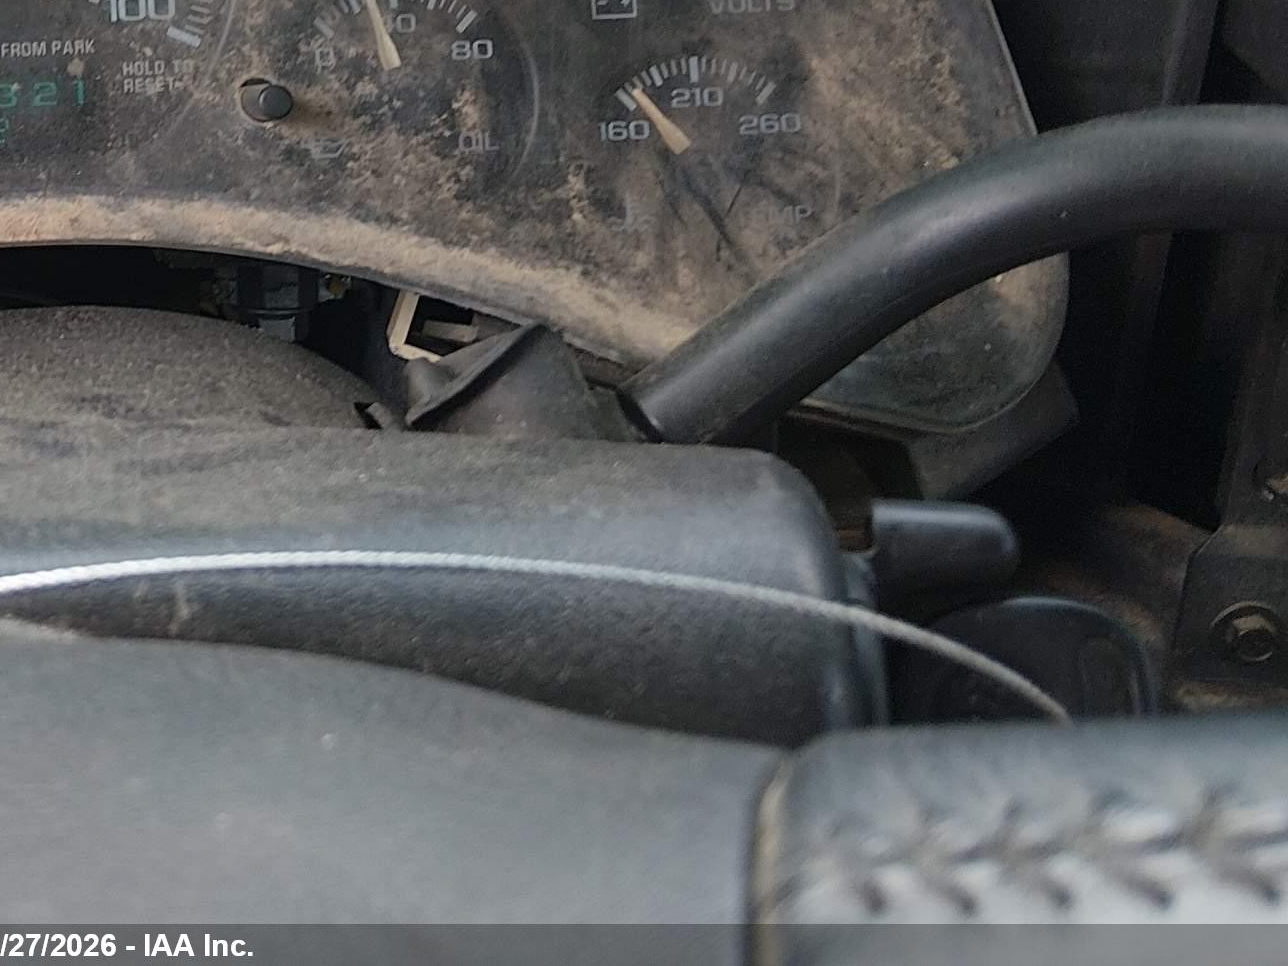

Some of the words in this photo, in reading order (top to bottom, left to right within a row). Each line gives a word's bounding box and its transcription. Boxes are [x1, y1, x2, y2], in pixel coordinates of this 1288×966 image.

[1, 41, 47, 58] FROM
[51, 39, 96, 55] PARK
[450, 39, 494, 61] 80
[122, 60, 165, 76] HOLD
[32, 82, 57, 106] 2
[72, 78, 85, 104] 1
[123, 77, 176, 94] RESET
[671, 87, 724, 109] 210
[599, 120, 650, 142] 160
[738, 112, 802, 135] 260
[458, 132, 501, 155] OIL
